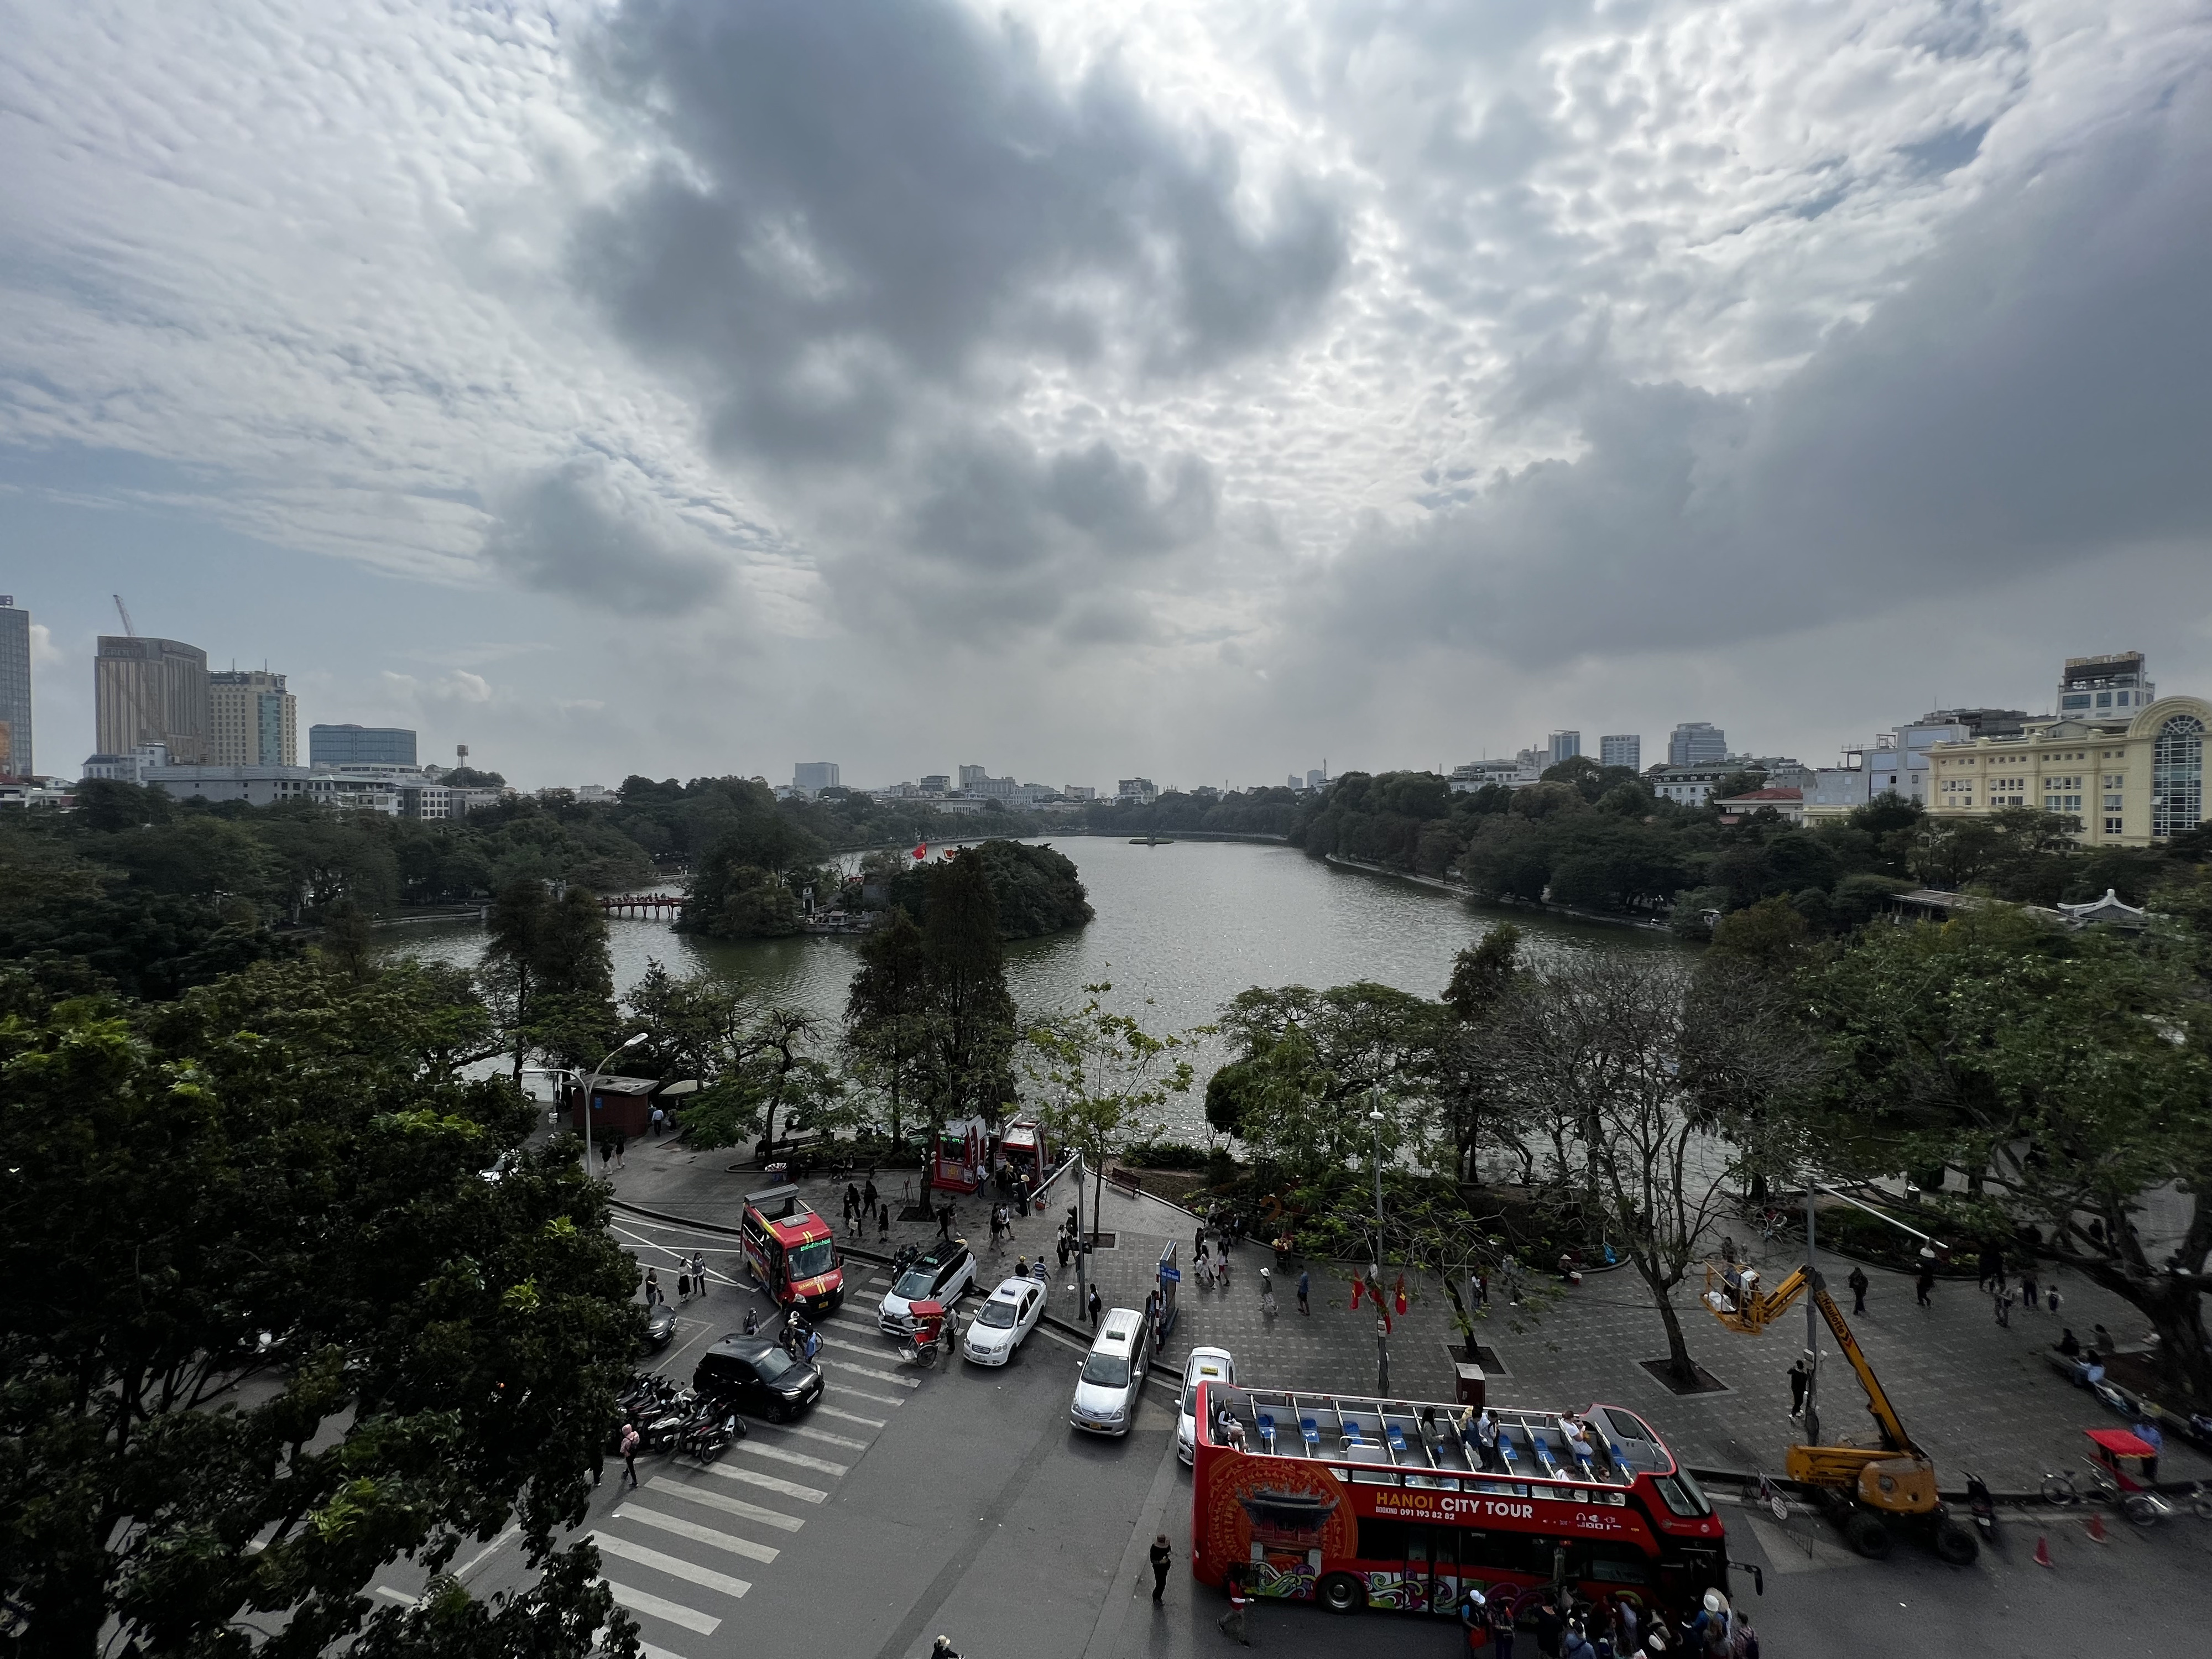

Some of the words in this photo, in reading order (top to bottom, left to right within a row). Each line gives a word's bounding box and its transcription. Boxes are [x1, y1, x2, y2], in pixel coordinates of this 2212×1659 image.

[1822, 1298, 1844, 1334] Haulotte
[1375, 1506, 1397, 1514] BOOKING
[1376, 1492, 1433, 1509] HANOI
[1441, 1498, 1480, 1514] CITY
[1485, 1501, 1533, 1519] TOUR
